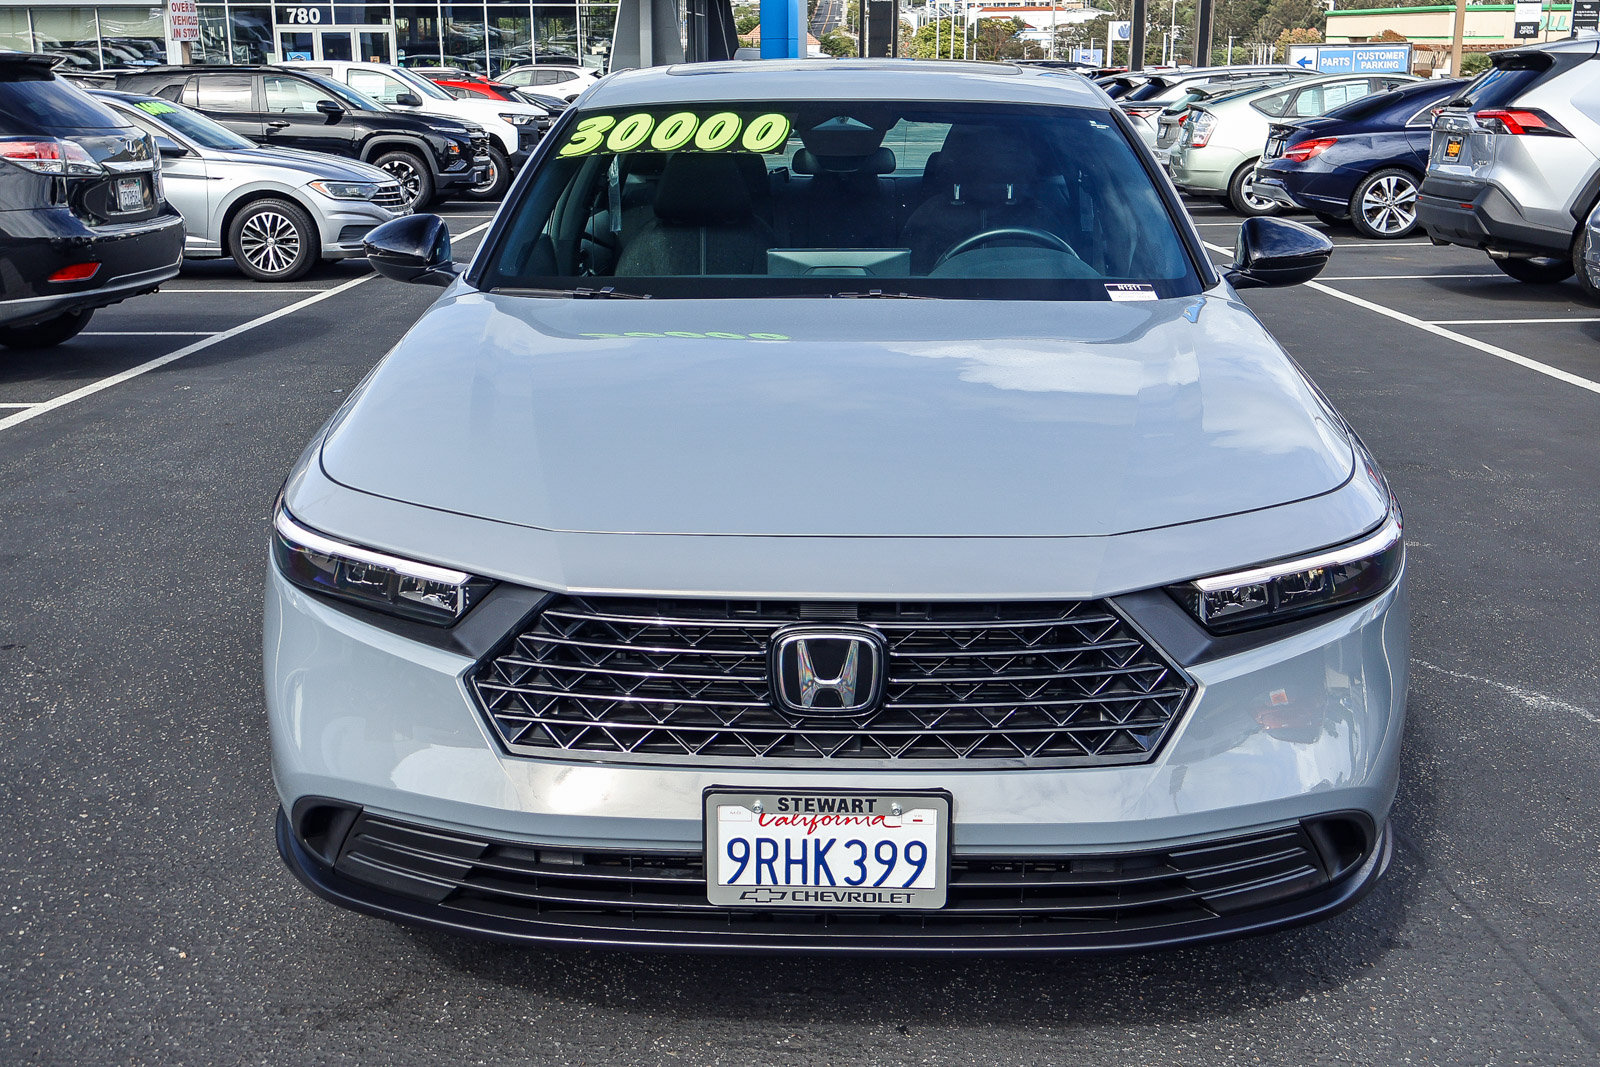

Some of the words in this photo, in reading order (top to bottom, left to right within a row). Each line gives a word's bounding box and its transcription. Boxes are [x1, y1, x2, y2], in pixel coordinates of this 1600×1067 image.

[171, 2, 189, 12] OVER
[171, 15, 198, 25] VEHICLES
[286, 7, 321, 24] 780
[173, 28, 181, 38] IN
[183, 28, 198, 38] STOCK
[1321, 57, 1350, 66] PARTS
[1356, 51, 1405, 60] CUSTOMER
[1361, 60, 1399, 69] PARKING
[557, 111, 791, 157] 30000
[777, 797, 877, 813] STEWART
[758, 813, 902, 835] California
[726, 837, 928, 889] 9RHK399
[791, 890, 916, 905] CHEVROLET
